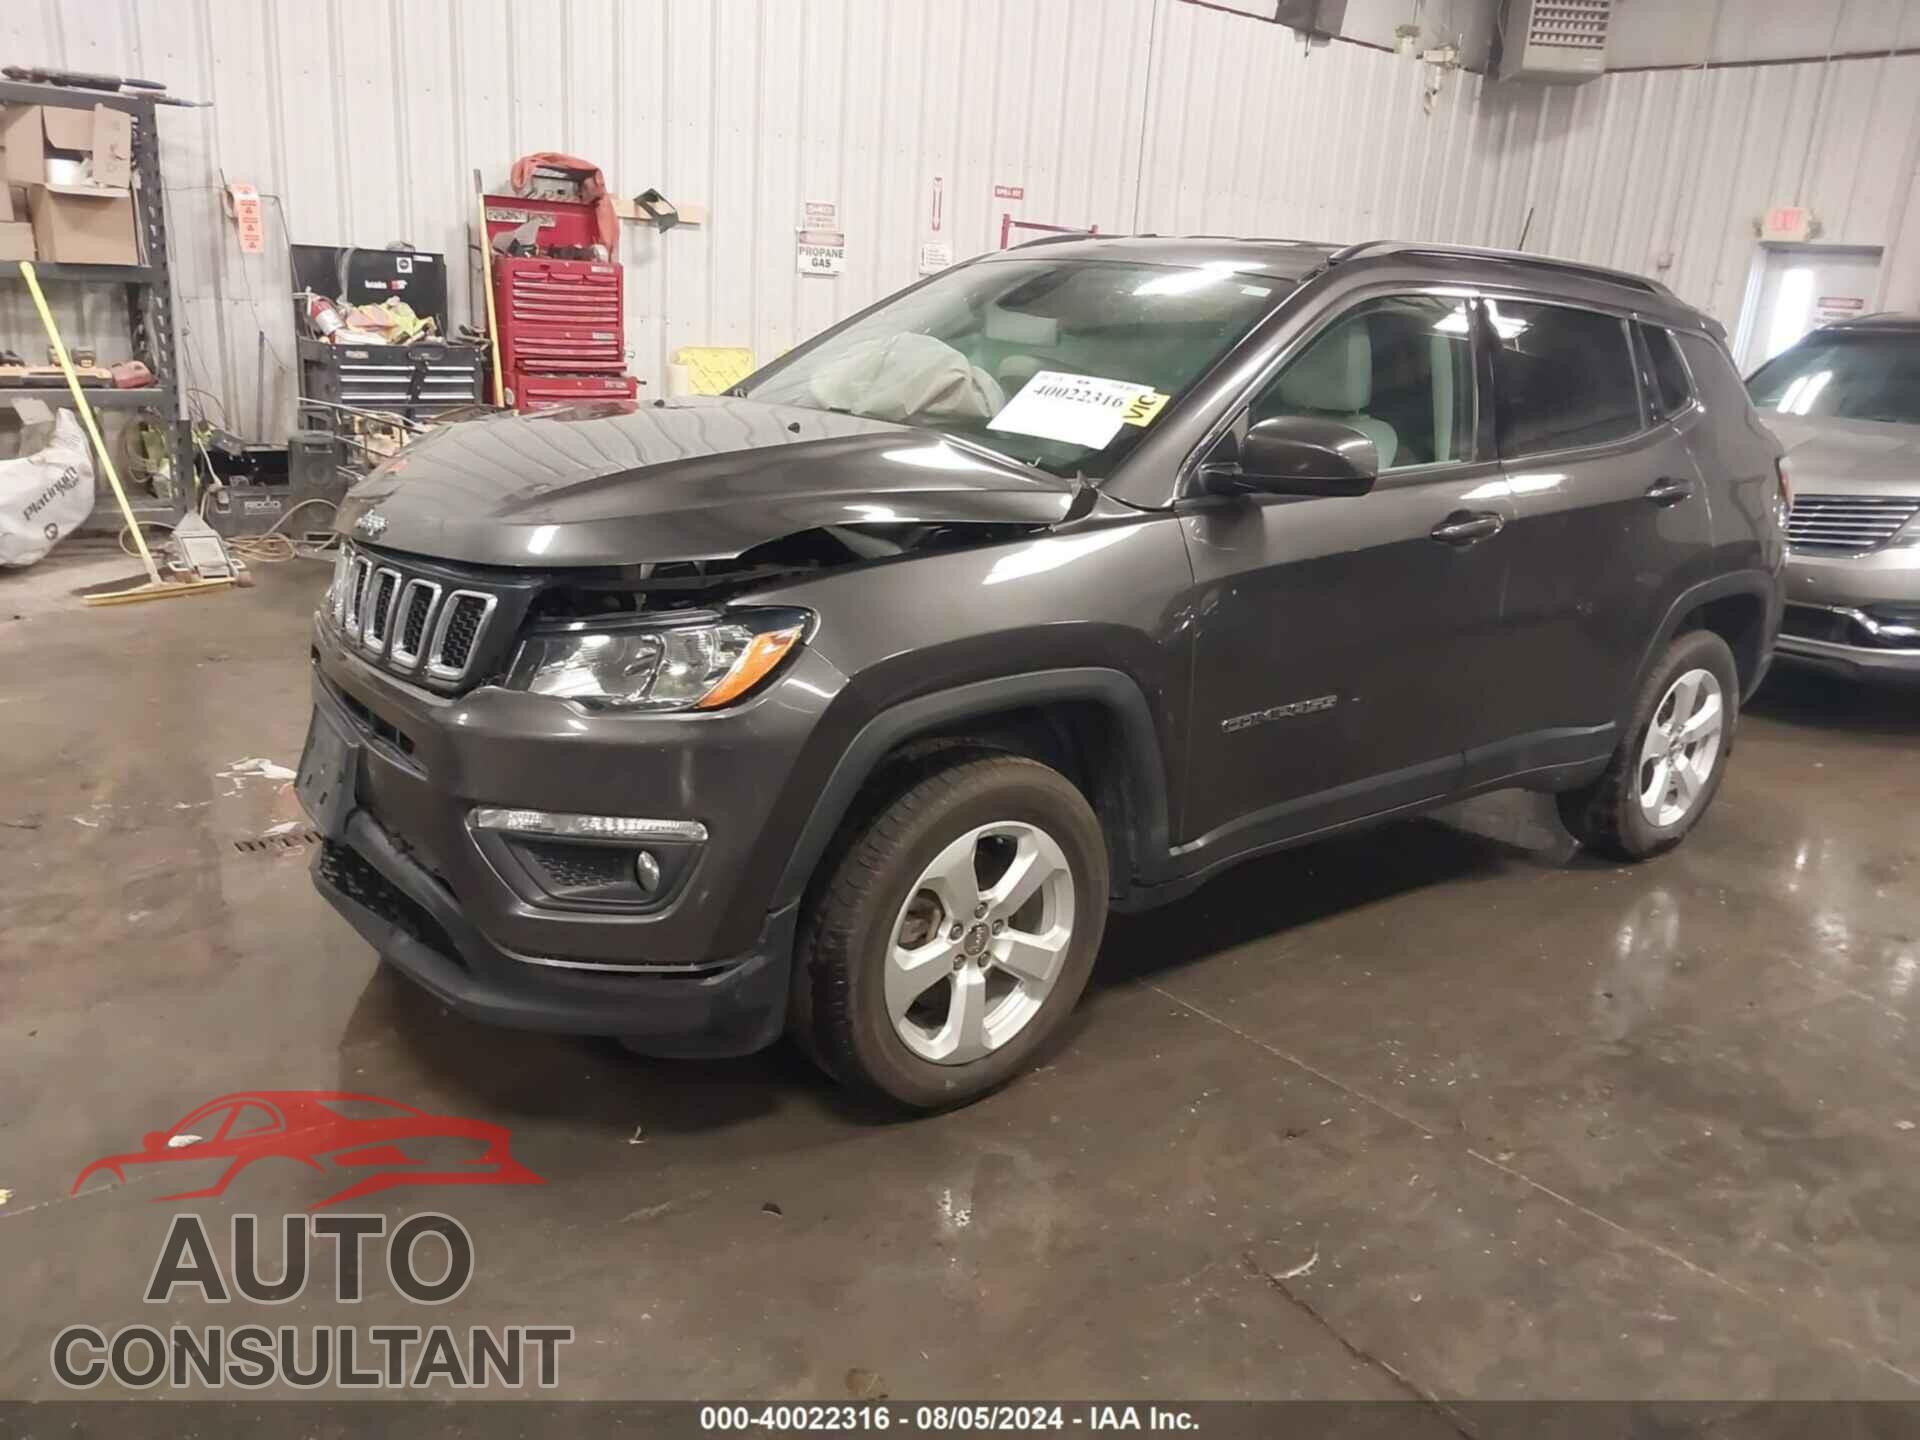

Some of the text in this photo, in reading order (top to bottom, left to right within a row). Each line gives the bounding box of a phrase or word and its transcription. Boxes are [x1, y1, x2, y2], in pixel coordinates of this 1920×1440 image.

[799, 246, 844, 258] PROPANE
[811, 258, 831, 268] GAS
[1034, 385, 1124, 408] 40022316
